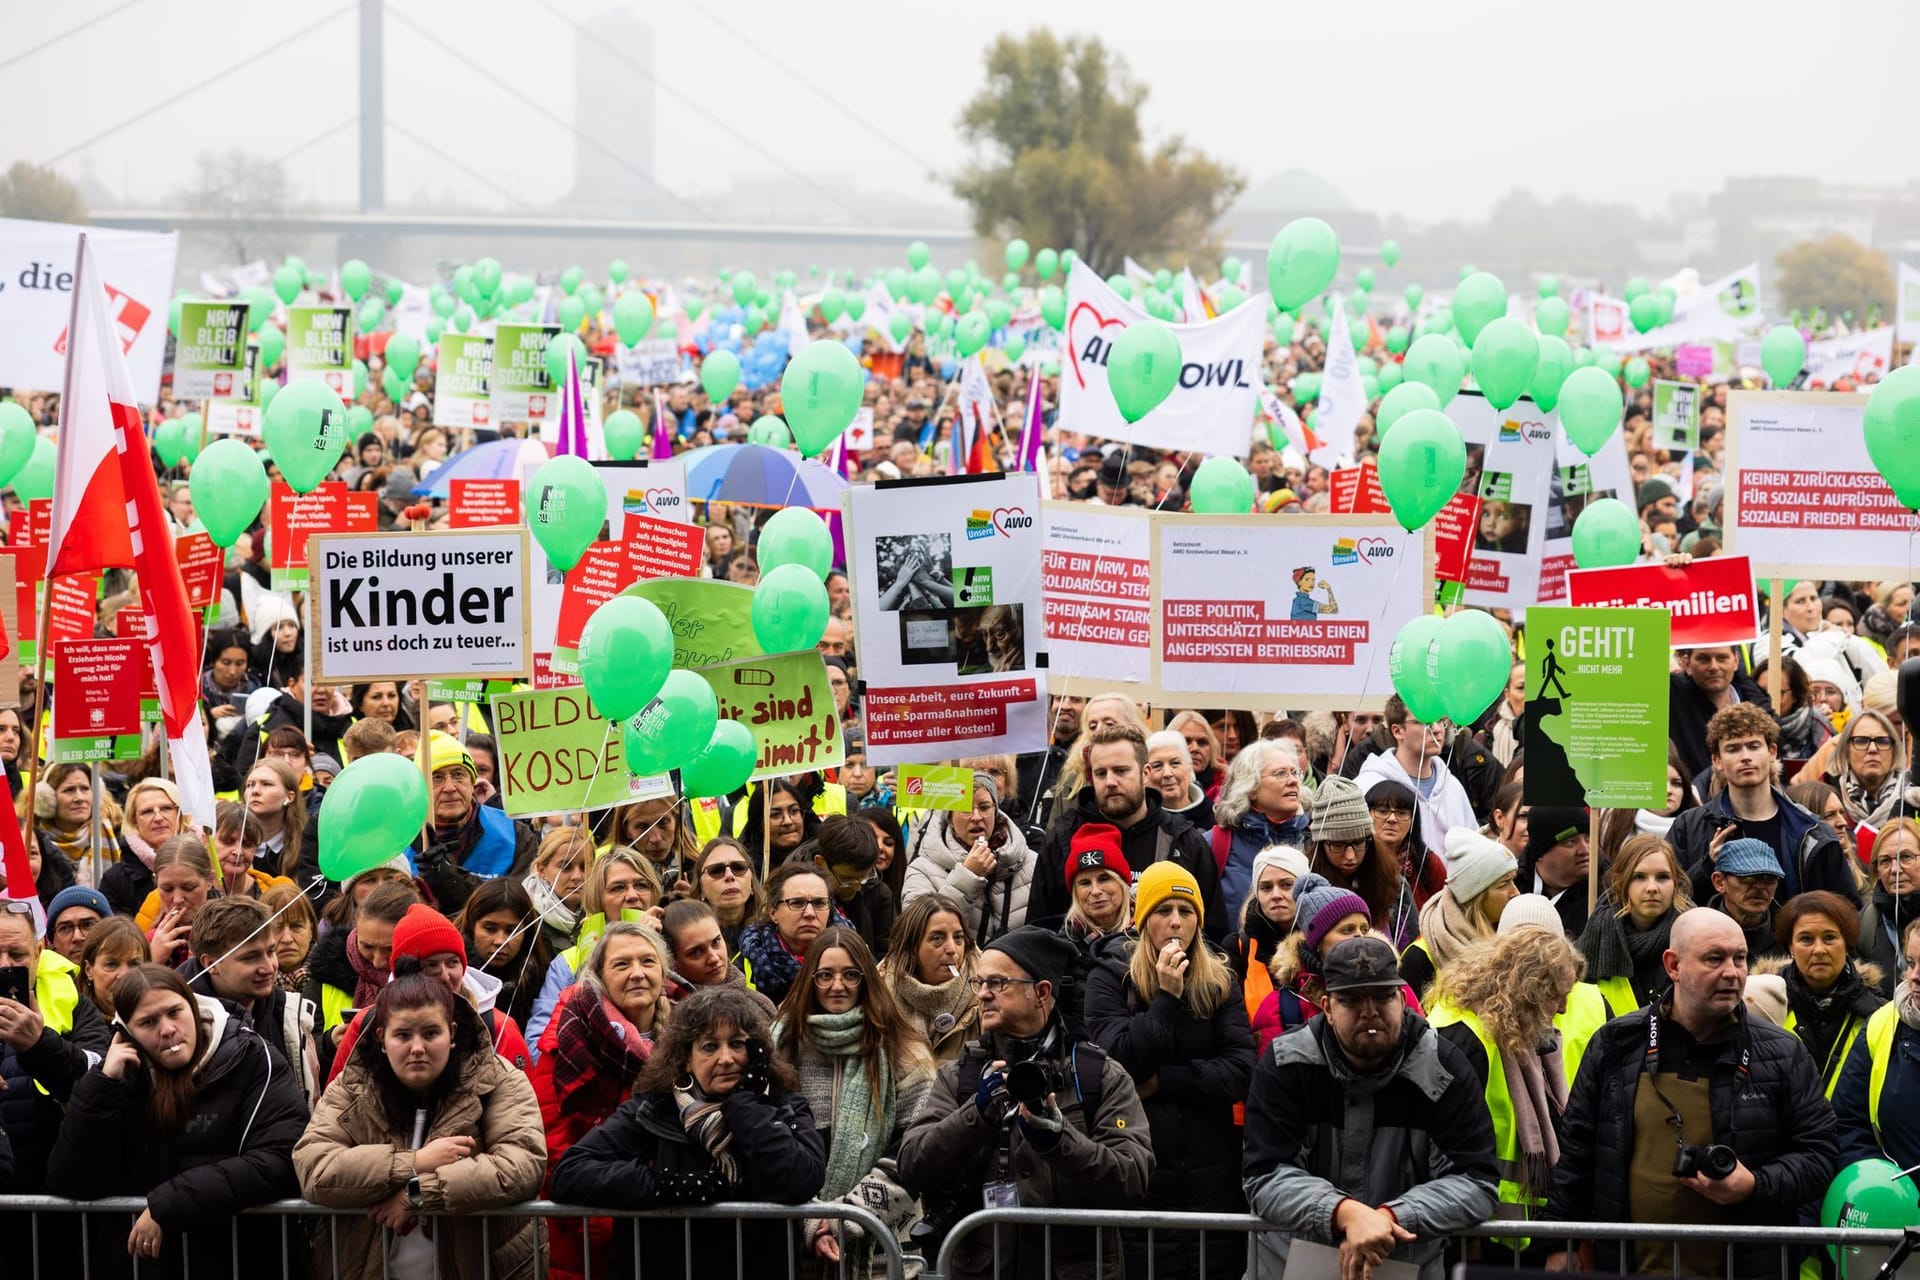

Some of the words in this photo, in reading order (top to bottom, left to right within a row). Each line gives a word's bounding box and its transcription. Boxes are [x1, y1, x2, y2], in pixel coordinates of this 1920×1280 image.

[18, 262, 73, 291] die
[206, 309, 239, 327] NRW
[312, 314, 343, 330] NRW
[197, 328, 238, 345] BLEIB
[305, 330, 342, 347] BLEIB
[463, 342, 494, 359] NRW
[499, 367, 548, 386] SOZIAL!
[1178, 359, 1249, 389] OWL
[1528, 429, 1551, 440] AWO
[1743, 473, 1790, 487] KEINEN
[548, 489, 566, 500] NRW
[655, 496, 680, 507] AWO
[1742, 490, 1768, 505] FÜR
[1770, 492, 1821, 505] SOZIALE
[543, 500, 566, 511] BLEIB
[1741, 510, 1799, 524] SOZIALEN
[1803, 511, 1856, 525] FRIEDEN
[639, 521, 653, 531] Wer
[653, 525, 688, 538] Menschen
[967, 527, 995, 539] Unsere
[1004, 516, 1033, 529] AWO
[651, 534, 688, 549] Abstellgleis
[326, 551, 358, 569] Die
[362, 548, 436, 571] Bildung
[441, 550, 514, 566] unserer
[1367, 546, 1394, 557] AWO
[628, 552, 691, 571] Rechtsextremismus
[1042, 552, 1067, 569] FÜR
[1069, 558, 1091, 571] EIN
[1094, 560, 1128, 578] NRW,
[1132, 564, 1150, 577] DA
[585, 566, 598, 575] Wir
[598, 570, 617, 580] zeige
[1119, 583, 1150, 597] STEH
[329, 572, 514, 629] Kinder
[1046, 602, 1111, 620] EMEINSAM
[1167, 604, 1202, 617] LIEBE
[1206, 604, 1260, 620] POLITIK,
[1058, 622, 1125, 641] MENSCHEN
[1167, 621, 1262, 638] UNTERSCHÄTZT
[1266, 624, 1323, 638] NIEMALS
[1326, 625, 1366, 639] EINEN
[91, 645, 108, 653] dass
[108, 644, 131, 652] meine
[328, 636, 349, 653] ist
[352, 638, 383, 652] uns
[387, 633, 429, 651] doch
[432, 636, 453, 650] zu
[456, 634, 516, 650] teuer...
[1167, 643, 1253, 657] ANGEPISSTEN
[1257, 644, 1347, 659] BETRIEBSRAT!
[1560, 626, 1635, 659] GEHT!
[68, 655, 103, 663] Erzieherin
[104, 653, 127, 662] Nicole
[73, 666, 95, 674] genug
[80, 674, 98, 682] mich
[1601, 664, 1623, 675] MEHR
[431, 688, 454, 699] BLEIB
[465, 682, 484, 691] NRW
[869, 693, 906, 705] Unsere
[909, 691, 946, 703] Arbeit,
[950, 692, 975, 701] eure
[978, 686, 1021, 699] Zukunft
[649, 702, 673, 720] NRW
[716, 696, 744, 720] ir
[751, 685, 814, 725] sind
[498, 694, 602, 735] BILDU
[641, 710, 665, 729] BLEIB
[870, 711, 900, 722] Keine
[903, 706, 998, 723] Sparmaßnahmen
[871, 729, 890, 740] auf
[892, 727, 923, 739] unser
[926, 725, 951, 737] aller
[954, 722, 995, 735] Kosten!
[94, 740, 112, 749] NRW
[755, 713, 835, 769] imit!
[62, 750, 84, 760] BLEIB
[84, 748, 114, 759] SOZIAL!
[1649, 1015, 1657, 1047] SONY
[1845, 1207, 1870, 1224] NRW
